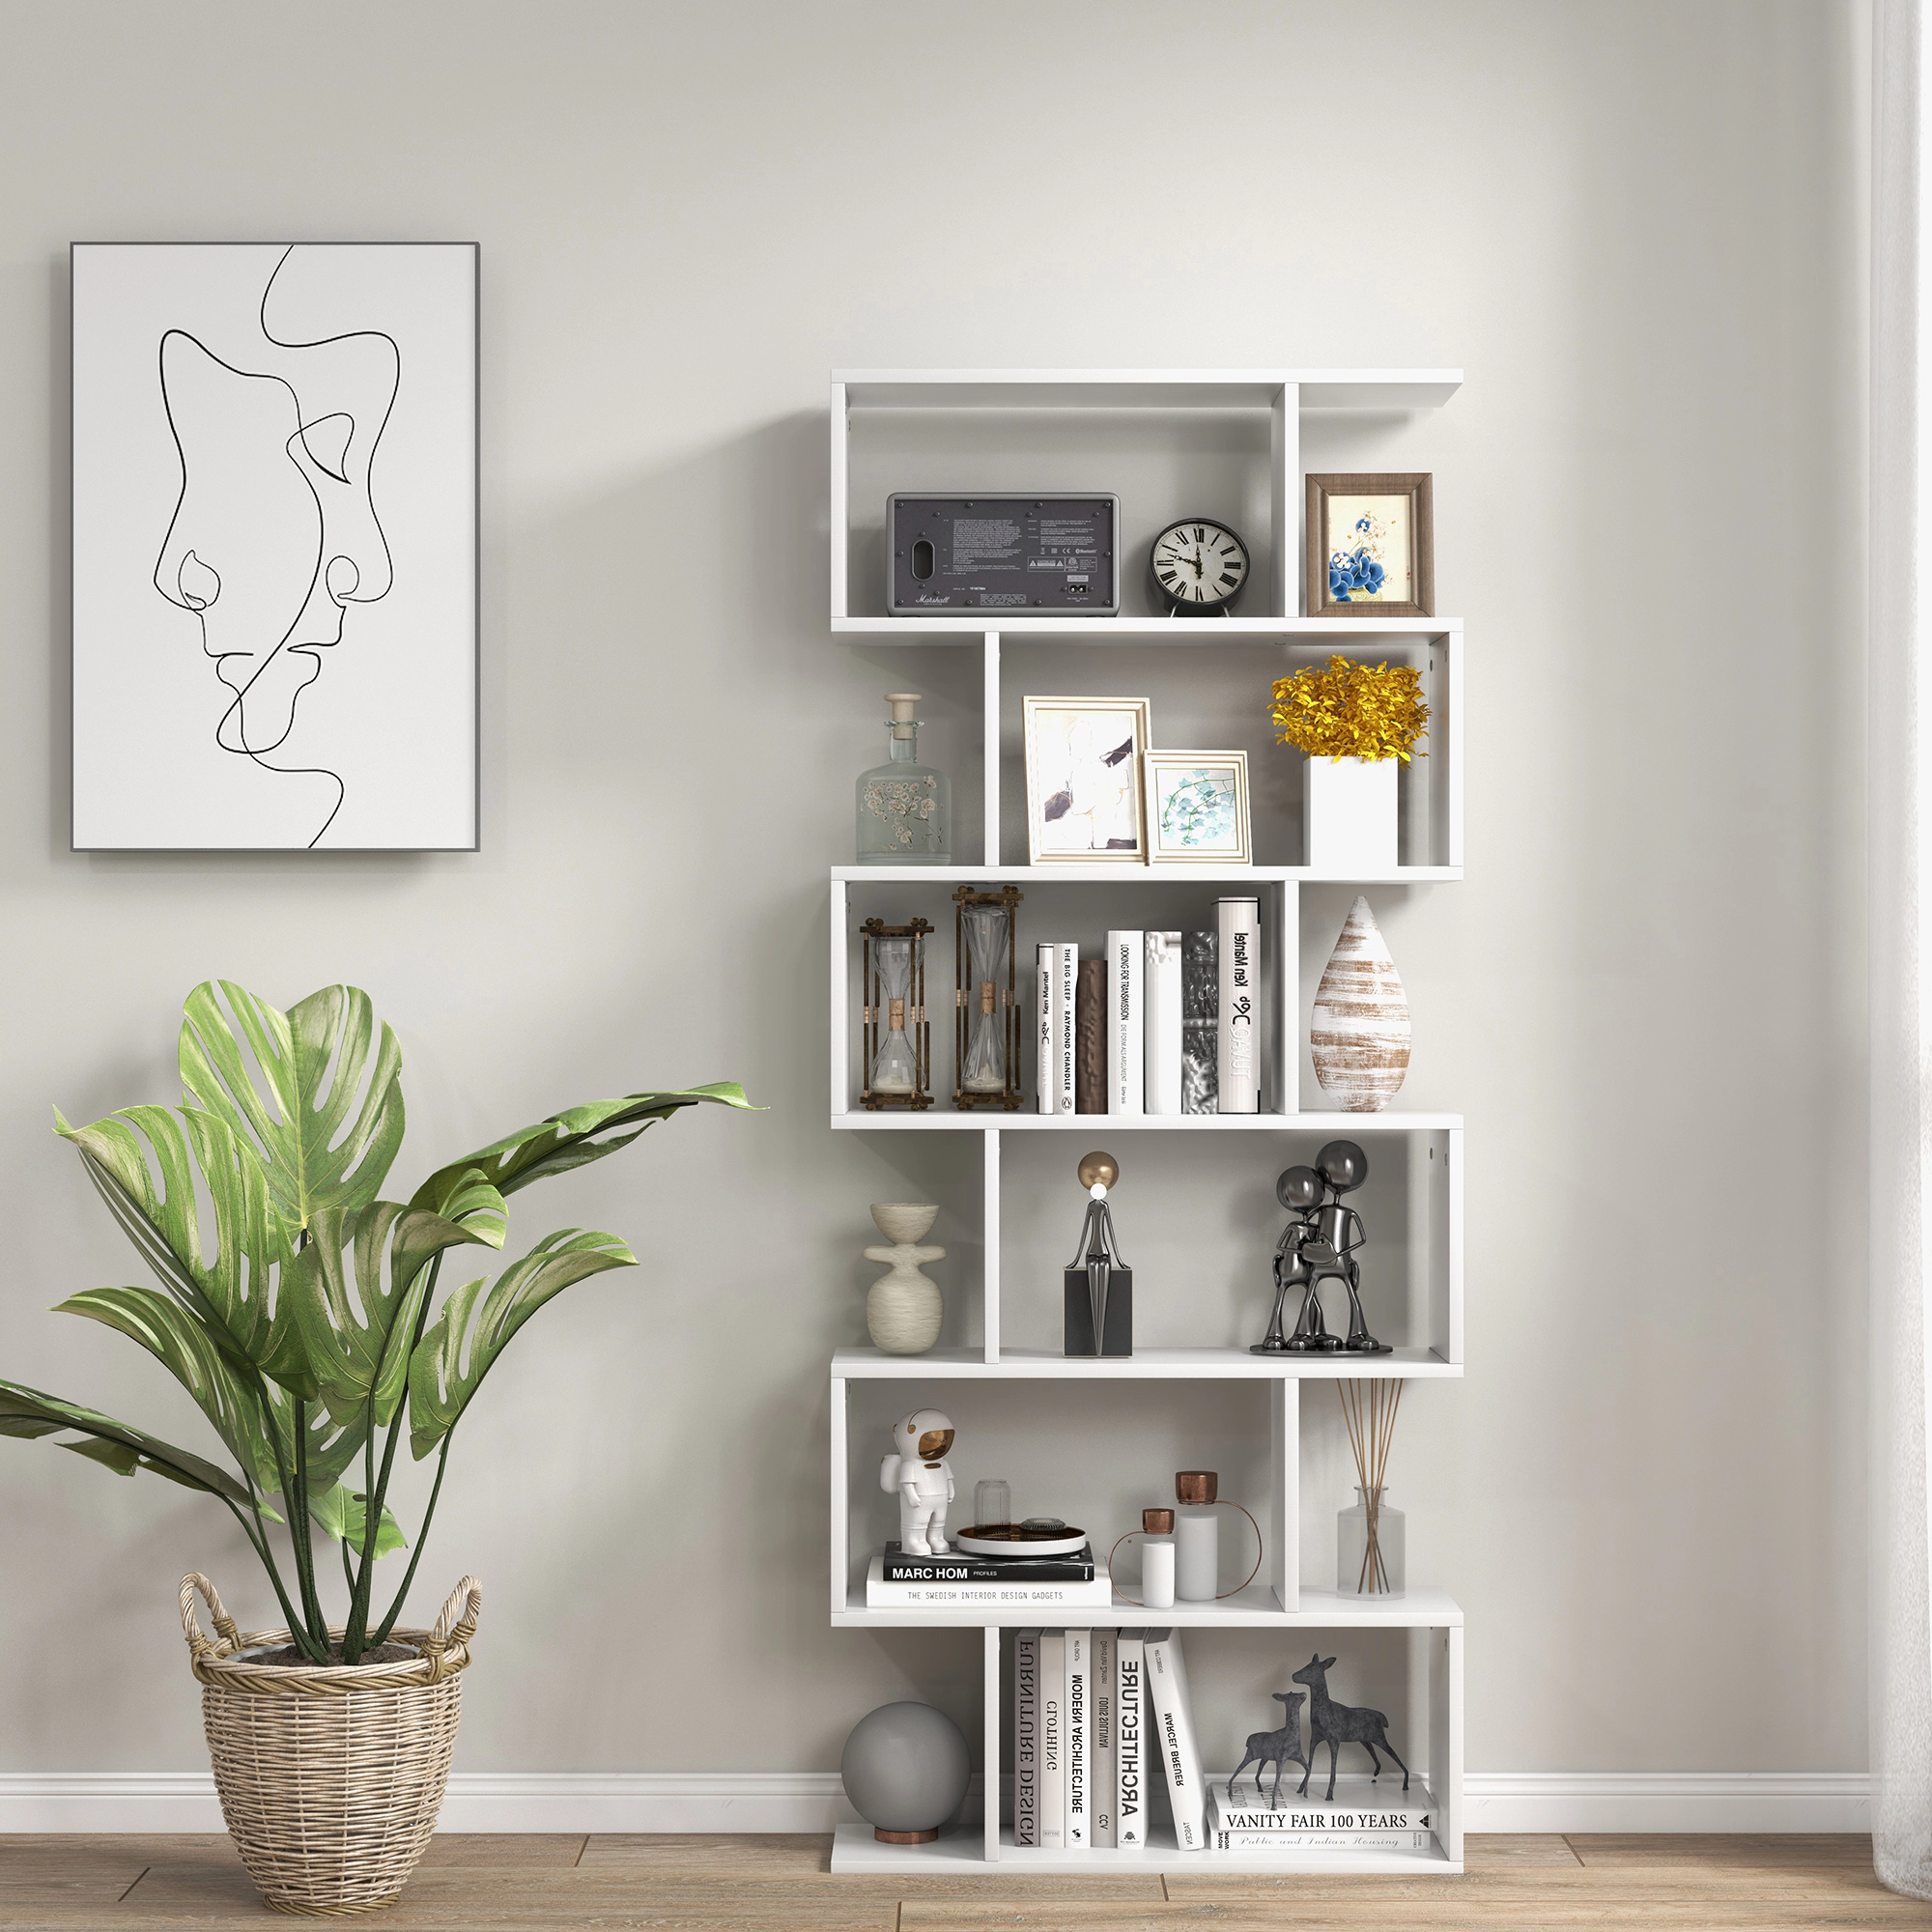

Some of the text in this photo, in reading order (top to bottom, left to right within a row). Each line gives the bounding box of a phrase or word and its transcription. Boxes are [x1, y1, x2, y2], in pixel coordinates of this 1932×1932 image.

[915, 594, 951, 604] Marshall
[893, 1568, 933, 1579] MARC
[936, 1568, 968, 1579] HOM
[1226, 1814, 1407, 1828] VANITY FAIR 100 YEARS
[1352, 1837, 1400, 1847] Housing
